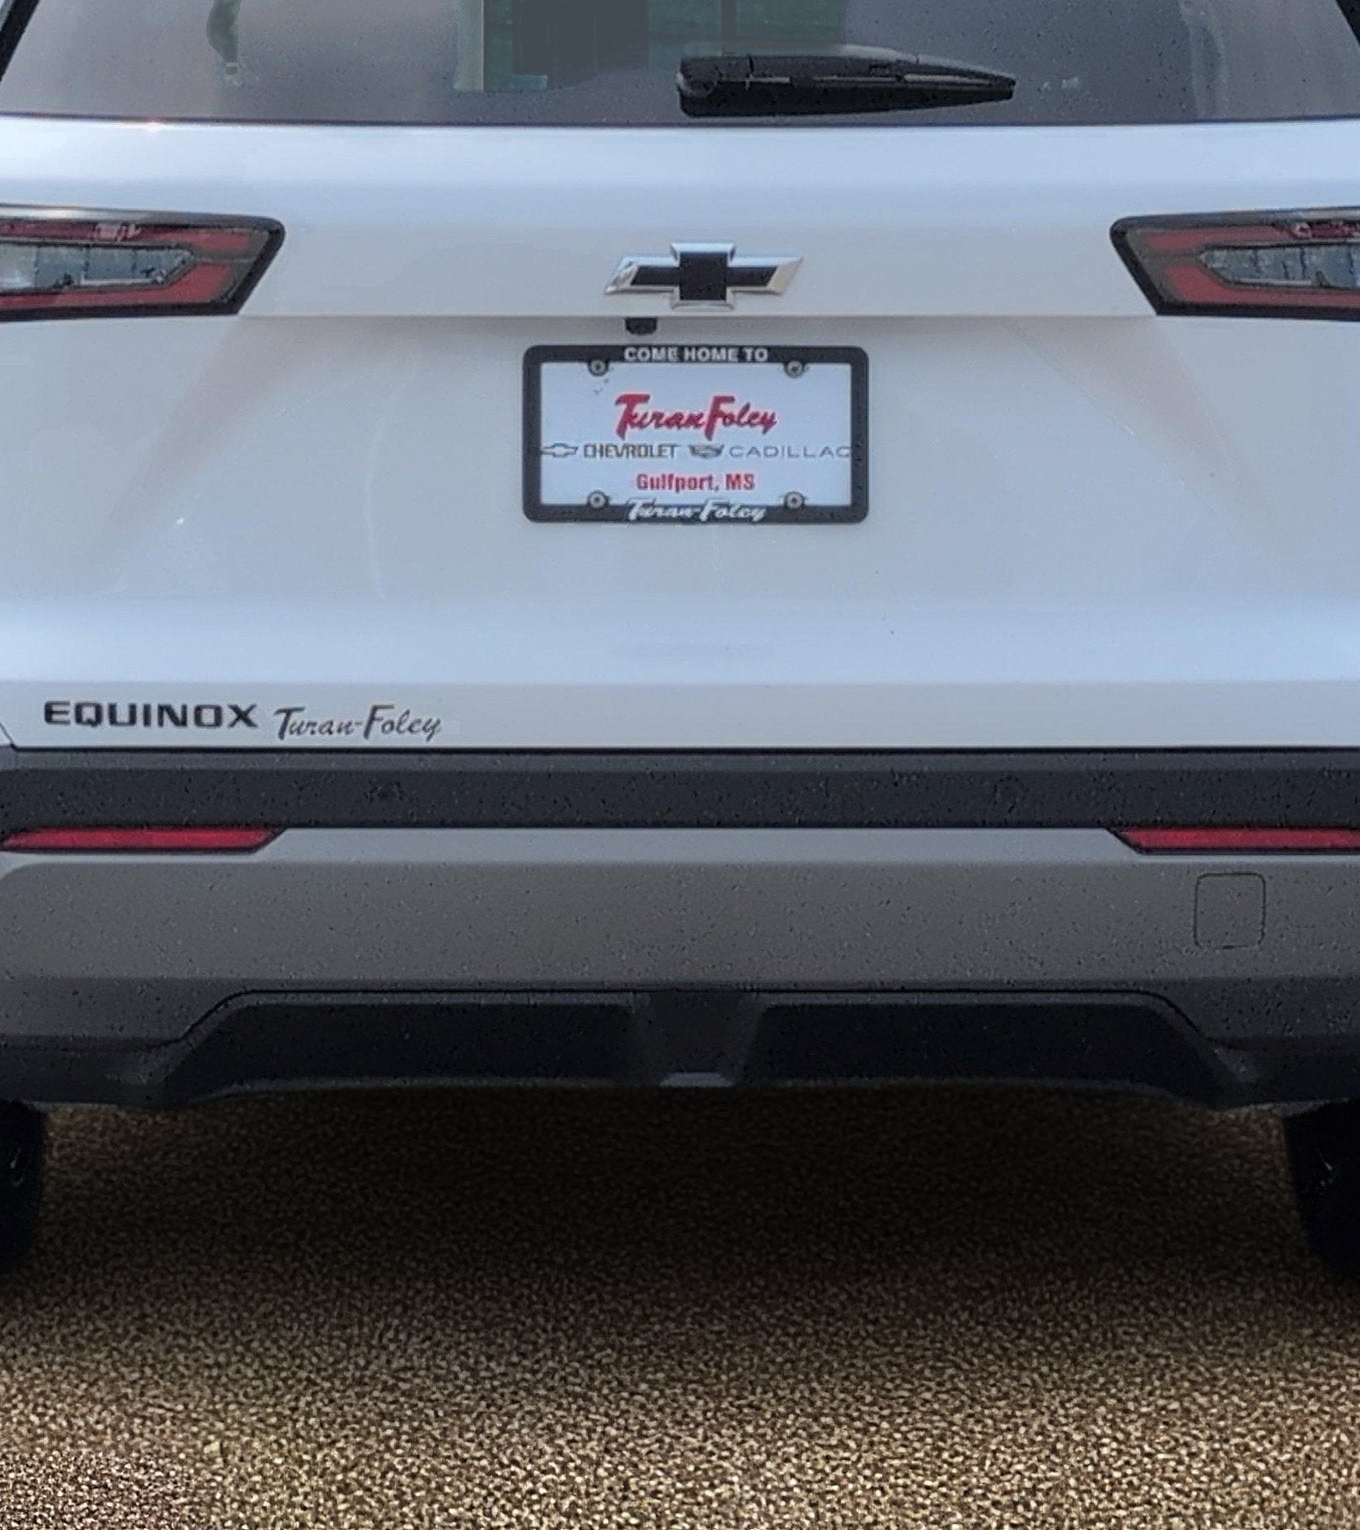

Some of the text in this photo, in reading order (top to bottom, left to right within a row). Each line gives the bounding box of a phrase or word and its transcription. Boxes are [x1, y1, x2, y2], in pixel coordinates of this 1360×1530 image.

[623, 346, 769, 362] COME HOME TO
[583, 443, 851, 458] CHEVROLET CADILLAC
[636, 473, 756, 493] Gulfport, MS
[43, 700, 259, 728] EQUINOX
